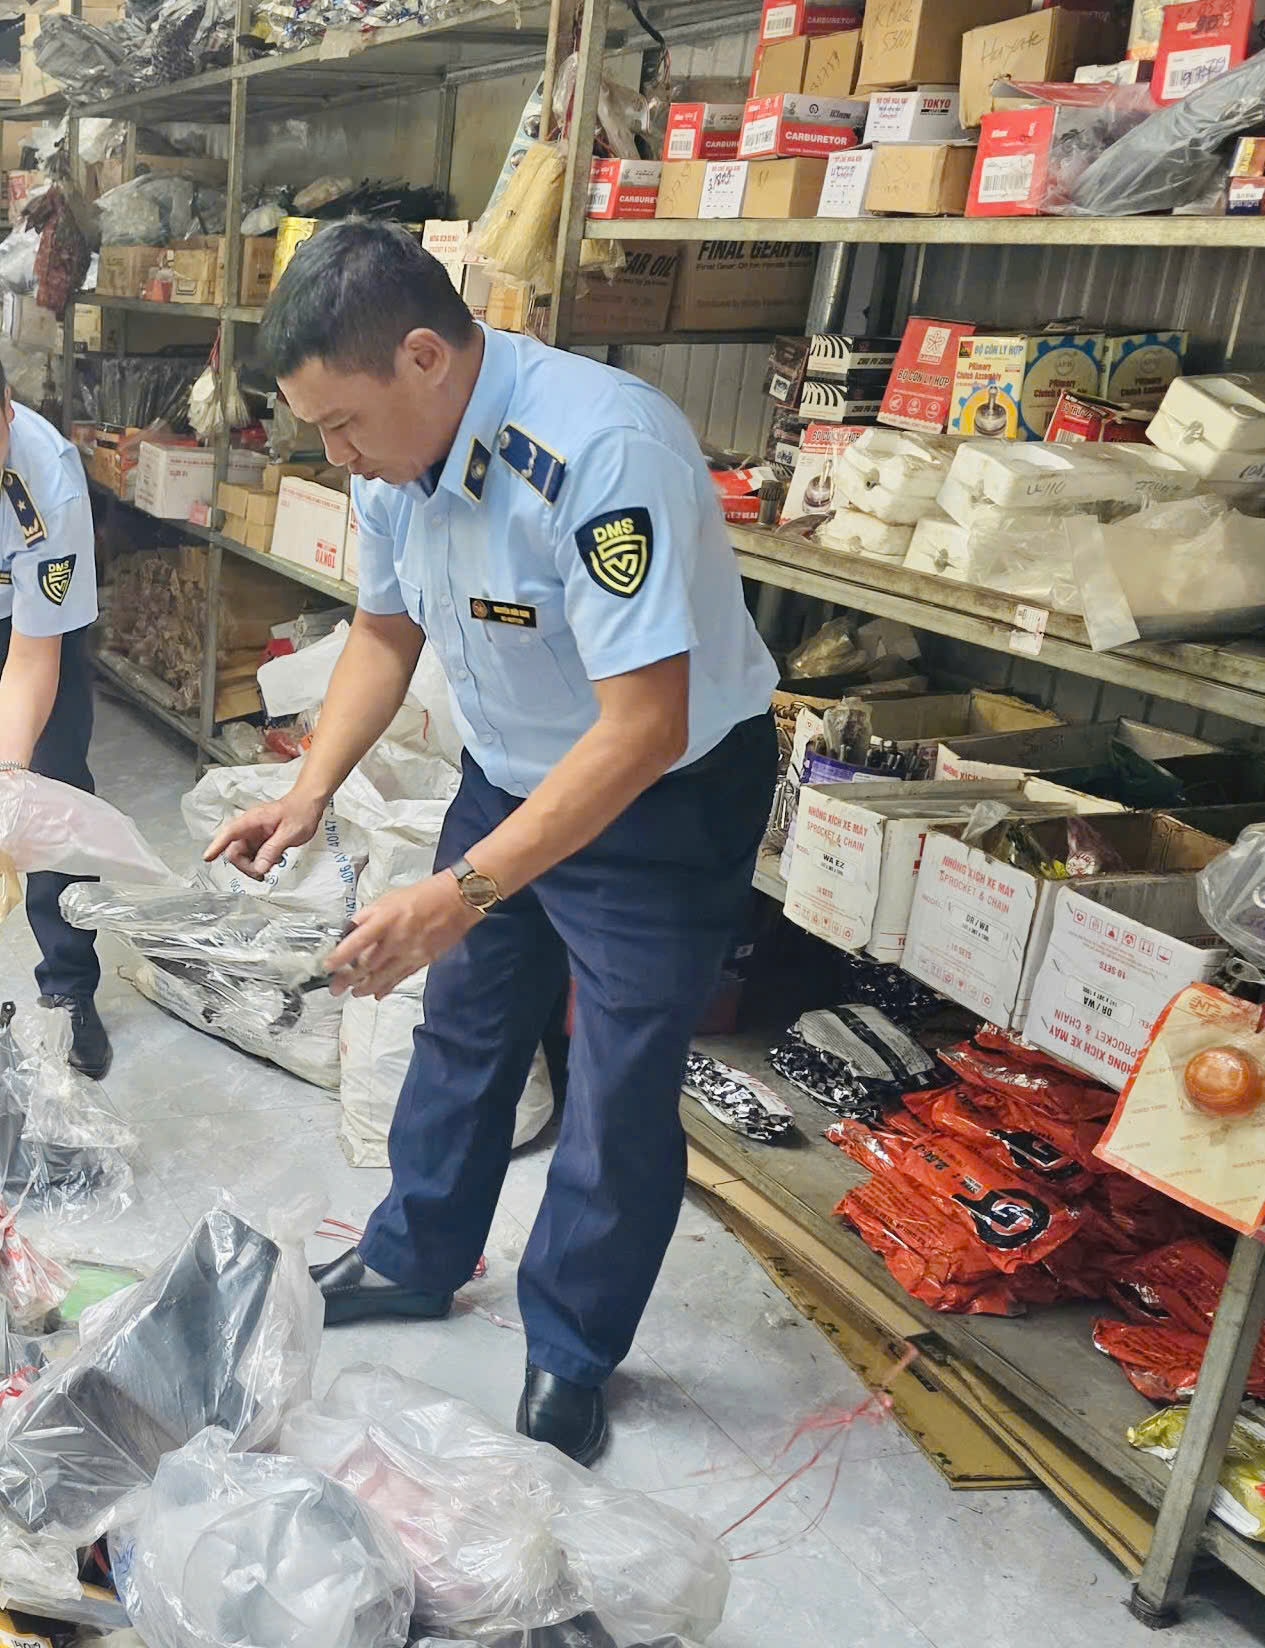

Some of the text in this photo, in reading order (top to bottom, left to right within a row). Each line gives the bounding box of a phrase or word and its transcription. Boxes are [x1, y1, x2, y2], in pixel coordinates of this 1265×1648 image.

[922, 98, 951, 108] TOKYO
[785, 130, 847, 146] CARBURETOR
[593, 517, 634, 545] DMS
[842, 820, 851, 832] XE
[852, 822, 868, 837] MÁY
[843, 836, 865, 853] CHAIN
[823, 853, 834, 864] WA
[835, 858, 845, 870] EZ
[942, 855, 1015, 898] NHÔNG XÍCH XE MÁY
[938, 870, 977, 898] SPROCKET
[987, 896, 1010, 914] CHAIN
[965, 914, 974, 925] DR
[979, 920, 990, 933] WA
[1099, 960, 1127, 980] 10 SETS
[1083, 996, 1096, 1009] WA
[1101, 1006, 1112, 1017] DR
[1054, 1009, 1082, 1031] CHAIN
[1048, 1024, 1068, 1043] MÁY
[1071, 1035, 1082, 1049] XE
[1084, 1041, 1108, 1061] XÍCH
